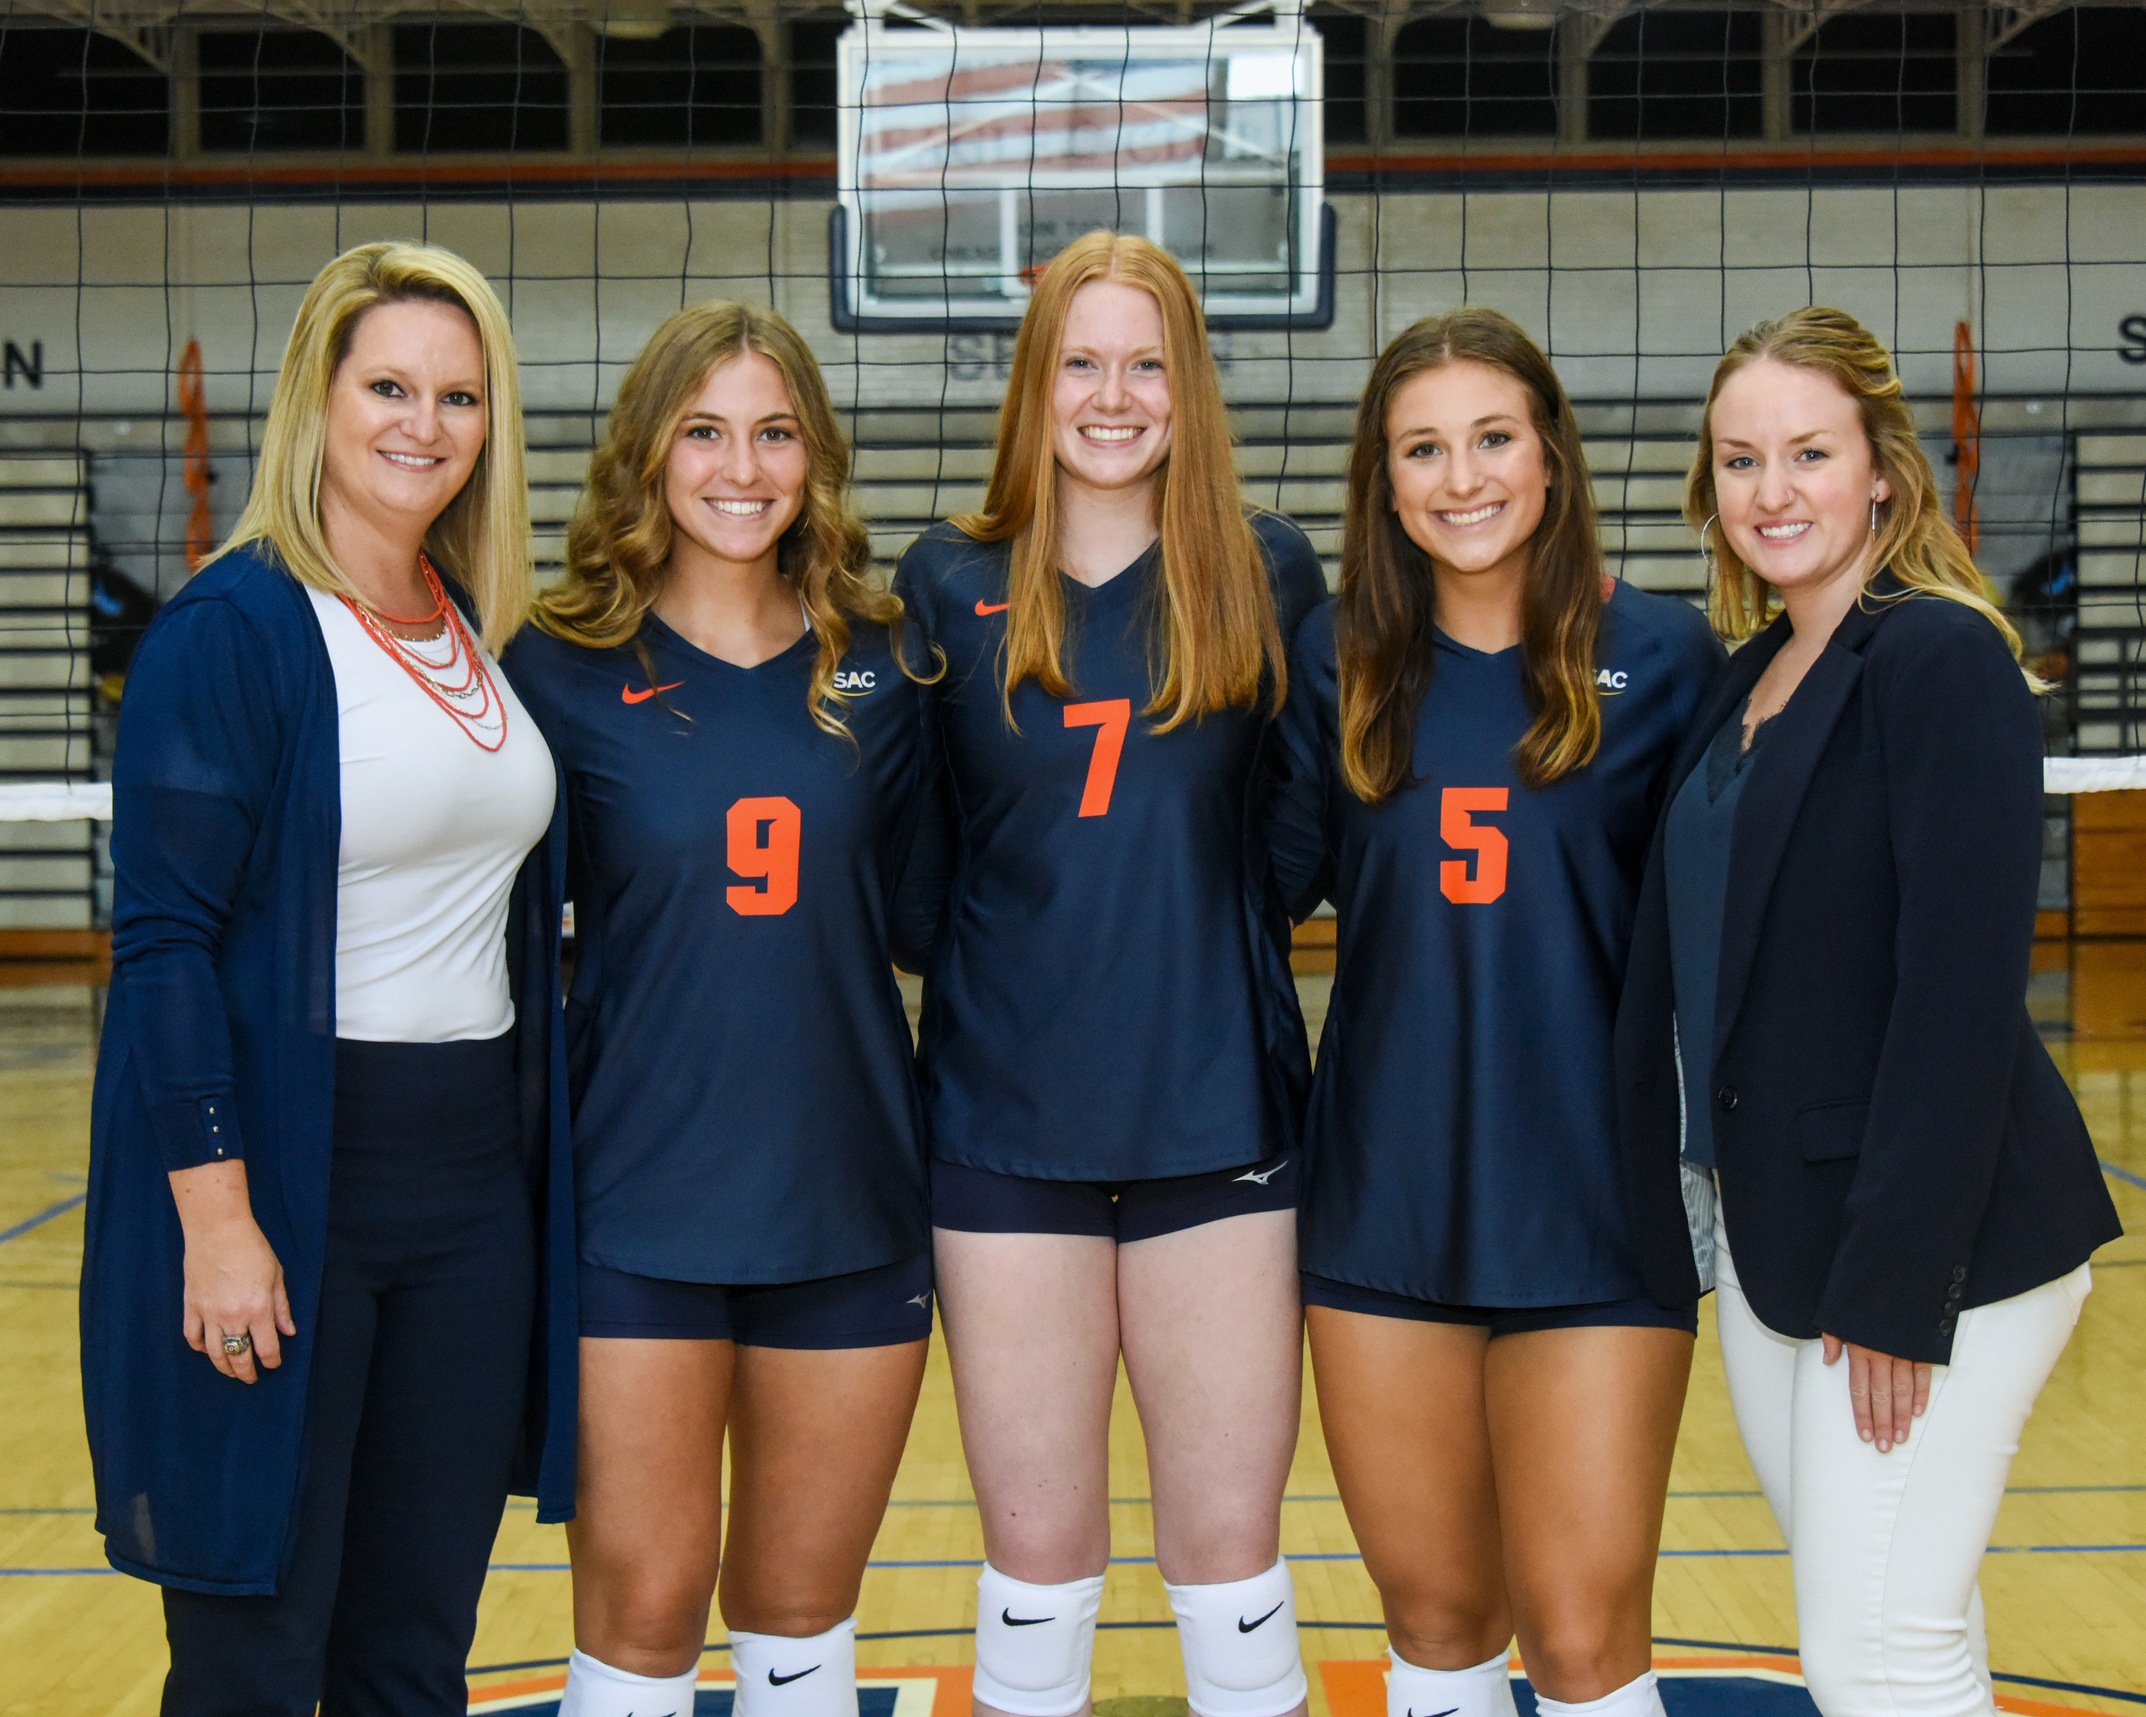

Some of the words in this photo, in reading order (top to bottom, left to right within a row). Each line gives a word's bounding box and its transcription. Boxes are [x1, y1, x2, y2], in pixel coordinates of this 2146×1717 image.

[833, 671, 876, 689] SAC
[1593, 669, 1629, 689] AC
[1063, 698, 1131, 817] 7
[726, 796, 801, 915] 9
[1440, 787, 1509, 904] 5
